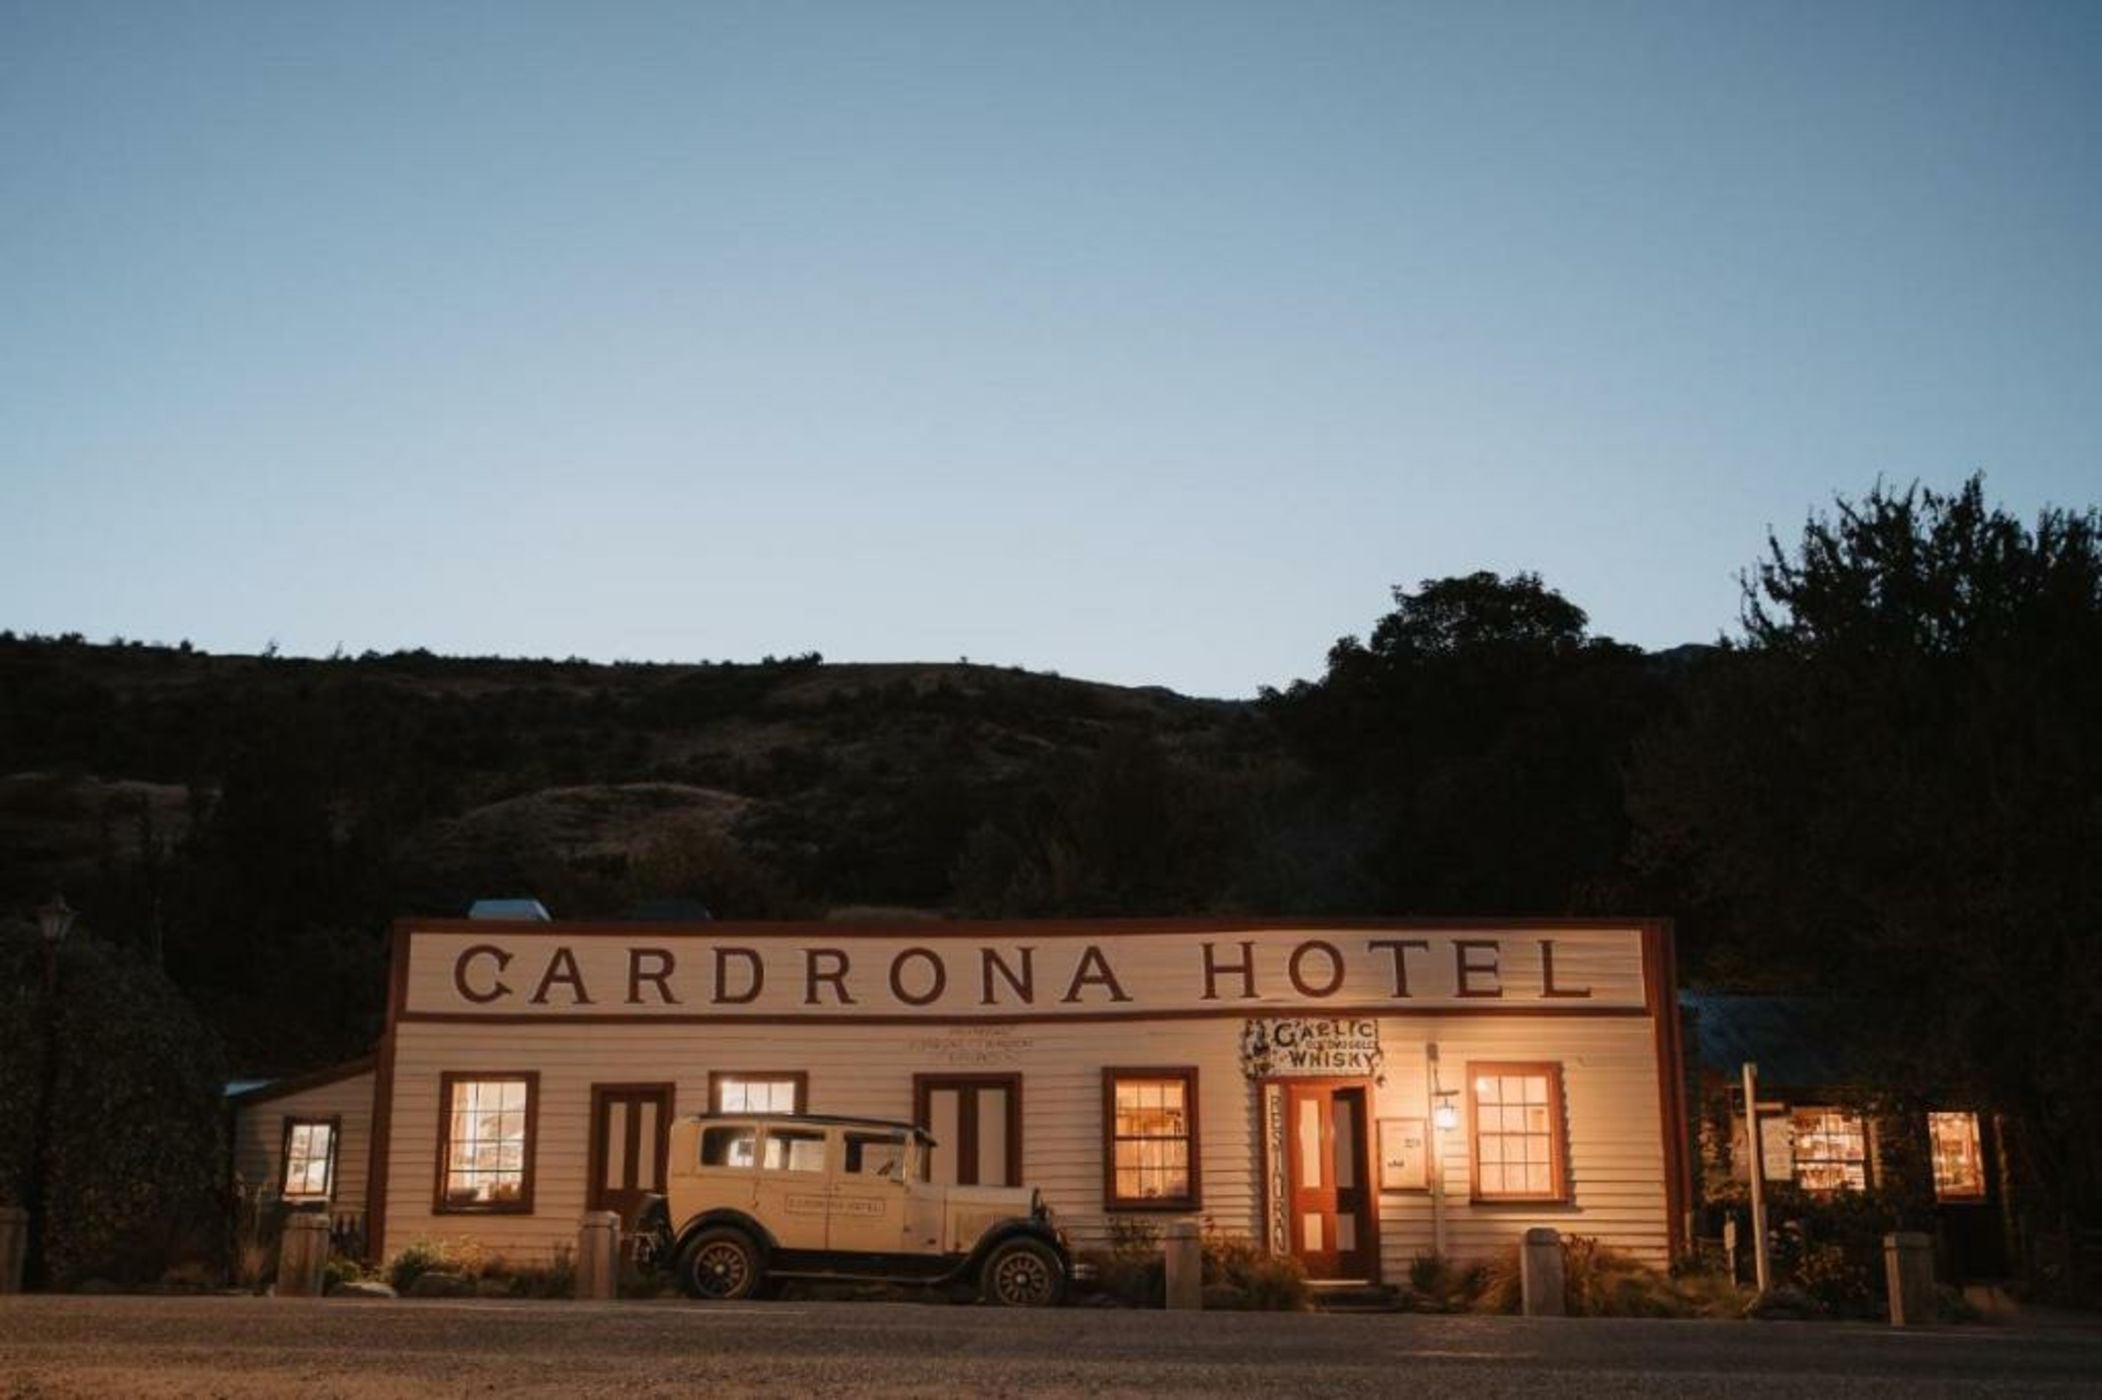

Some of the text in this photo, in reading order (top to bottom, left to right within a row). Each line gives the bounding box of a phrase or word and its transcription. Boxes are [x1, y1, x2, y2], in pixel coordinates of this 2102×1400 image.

[453, 938, 1592, 1007] CARDRONA HOTEL
[1288, 1050, 1377, 1068] WHISKY
